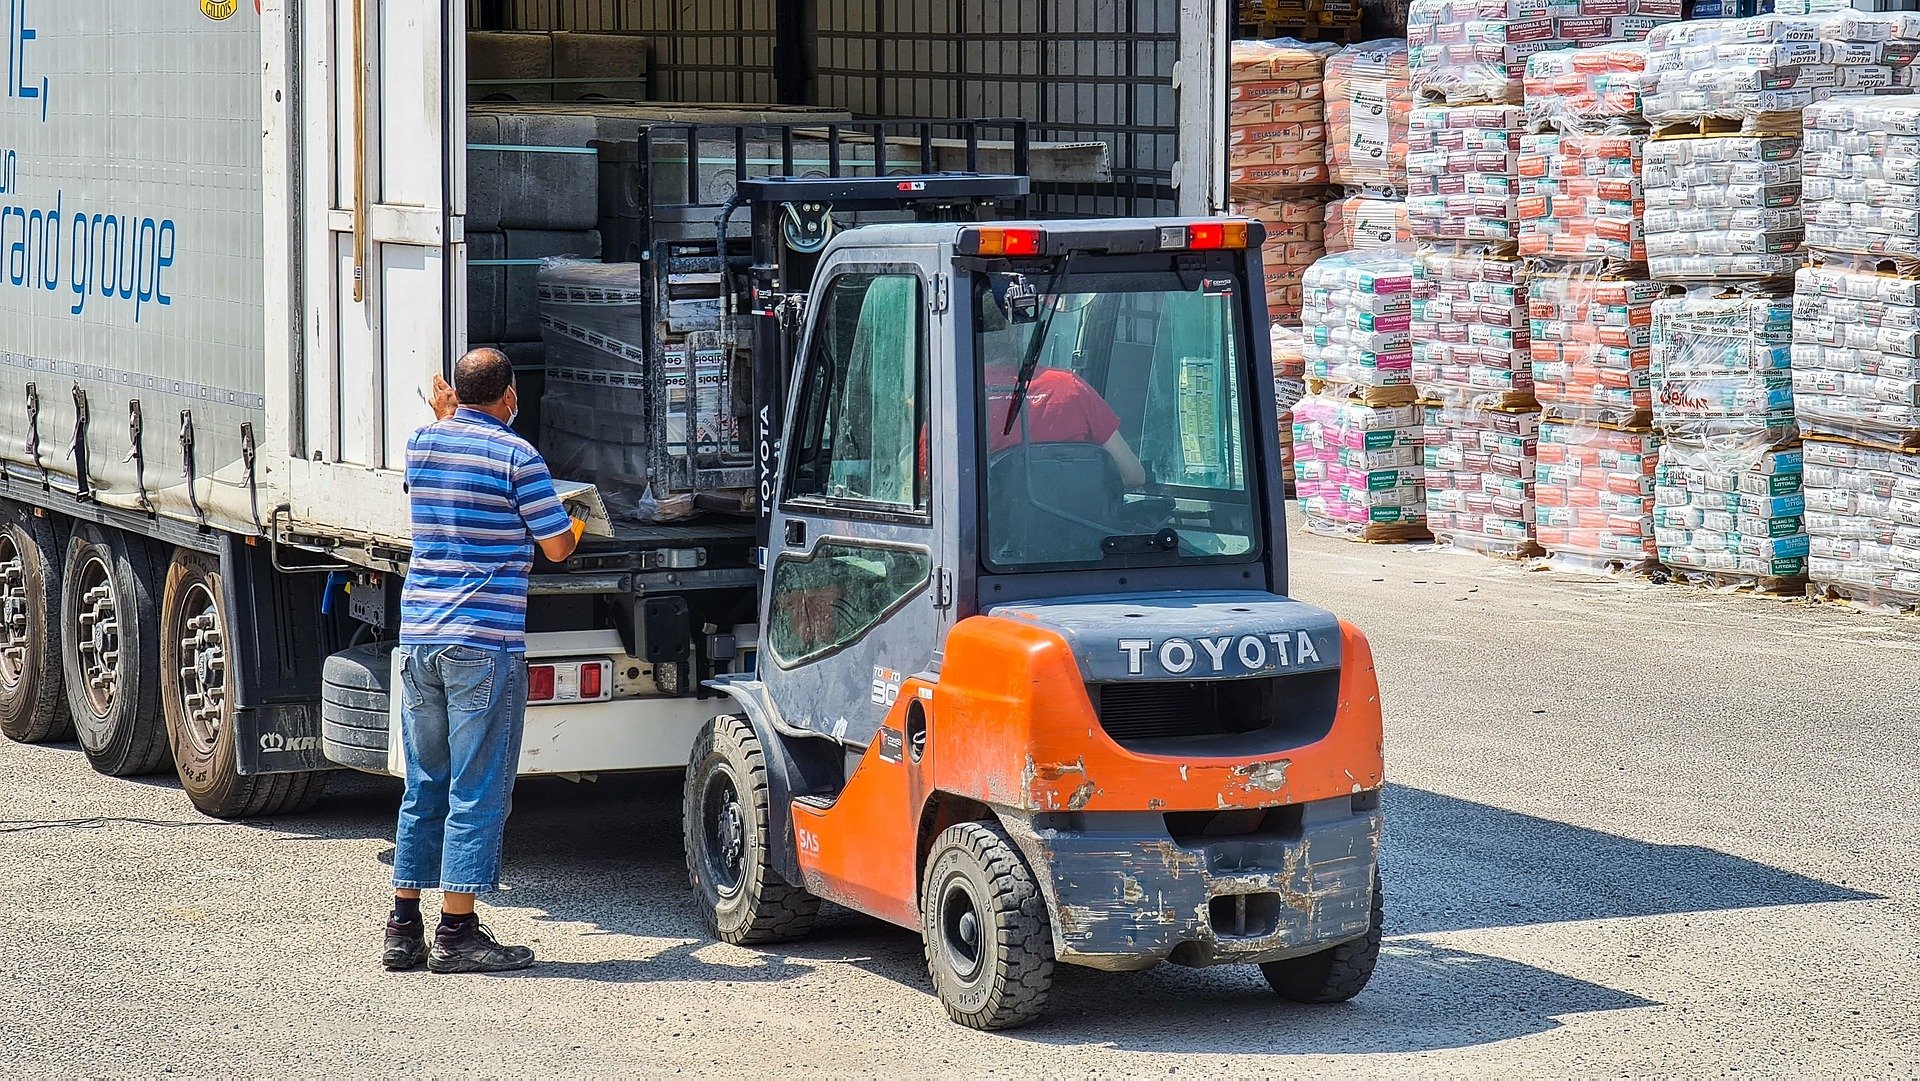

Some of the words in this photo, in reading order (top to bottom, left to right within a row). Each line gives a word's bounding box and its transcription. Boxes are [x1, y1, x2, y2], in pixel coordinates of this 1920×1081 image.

[1509, 22, 1539, 30] MONOMAX
[71, 213, 174, 322] groupe
[760, 404, 770, 518] TOYOTA
[1119, 630, 1320, 675] TOYOTA
[800, 829, 819, 852] SAS
